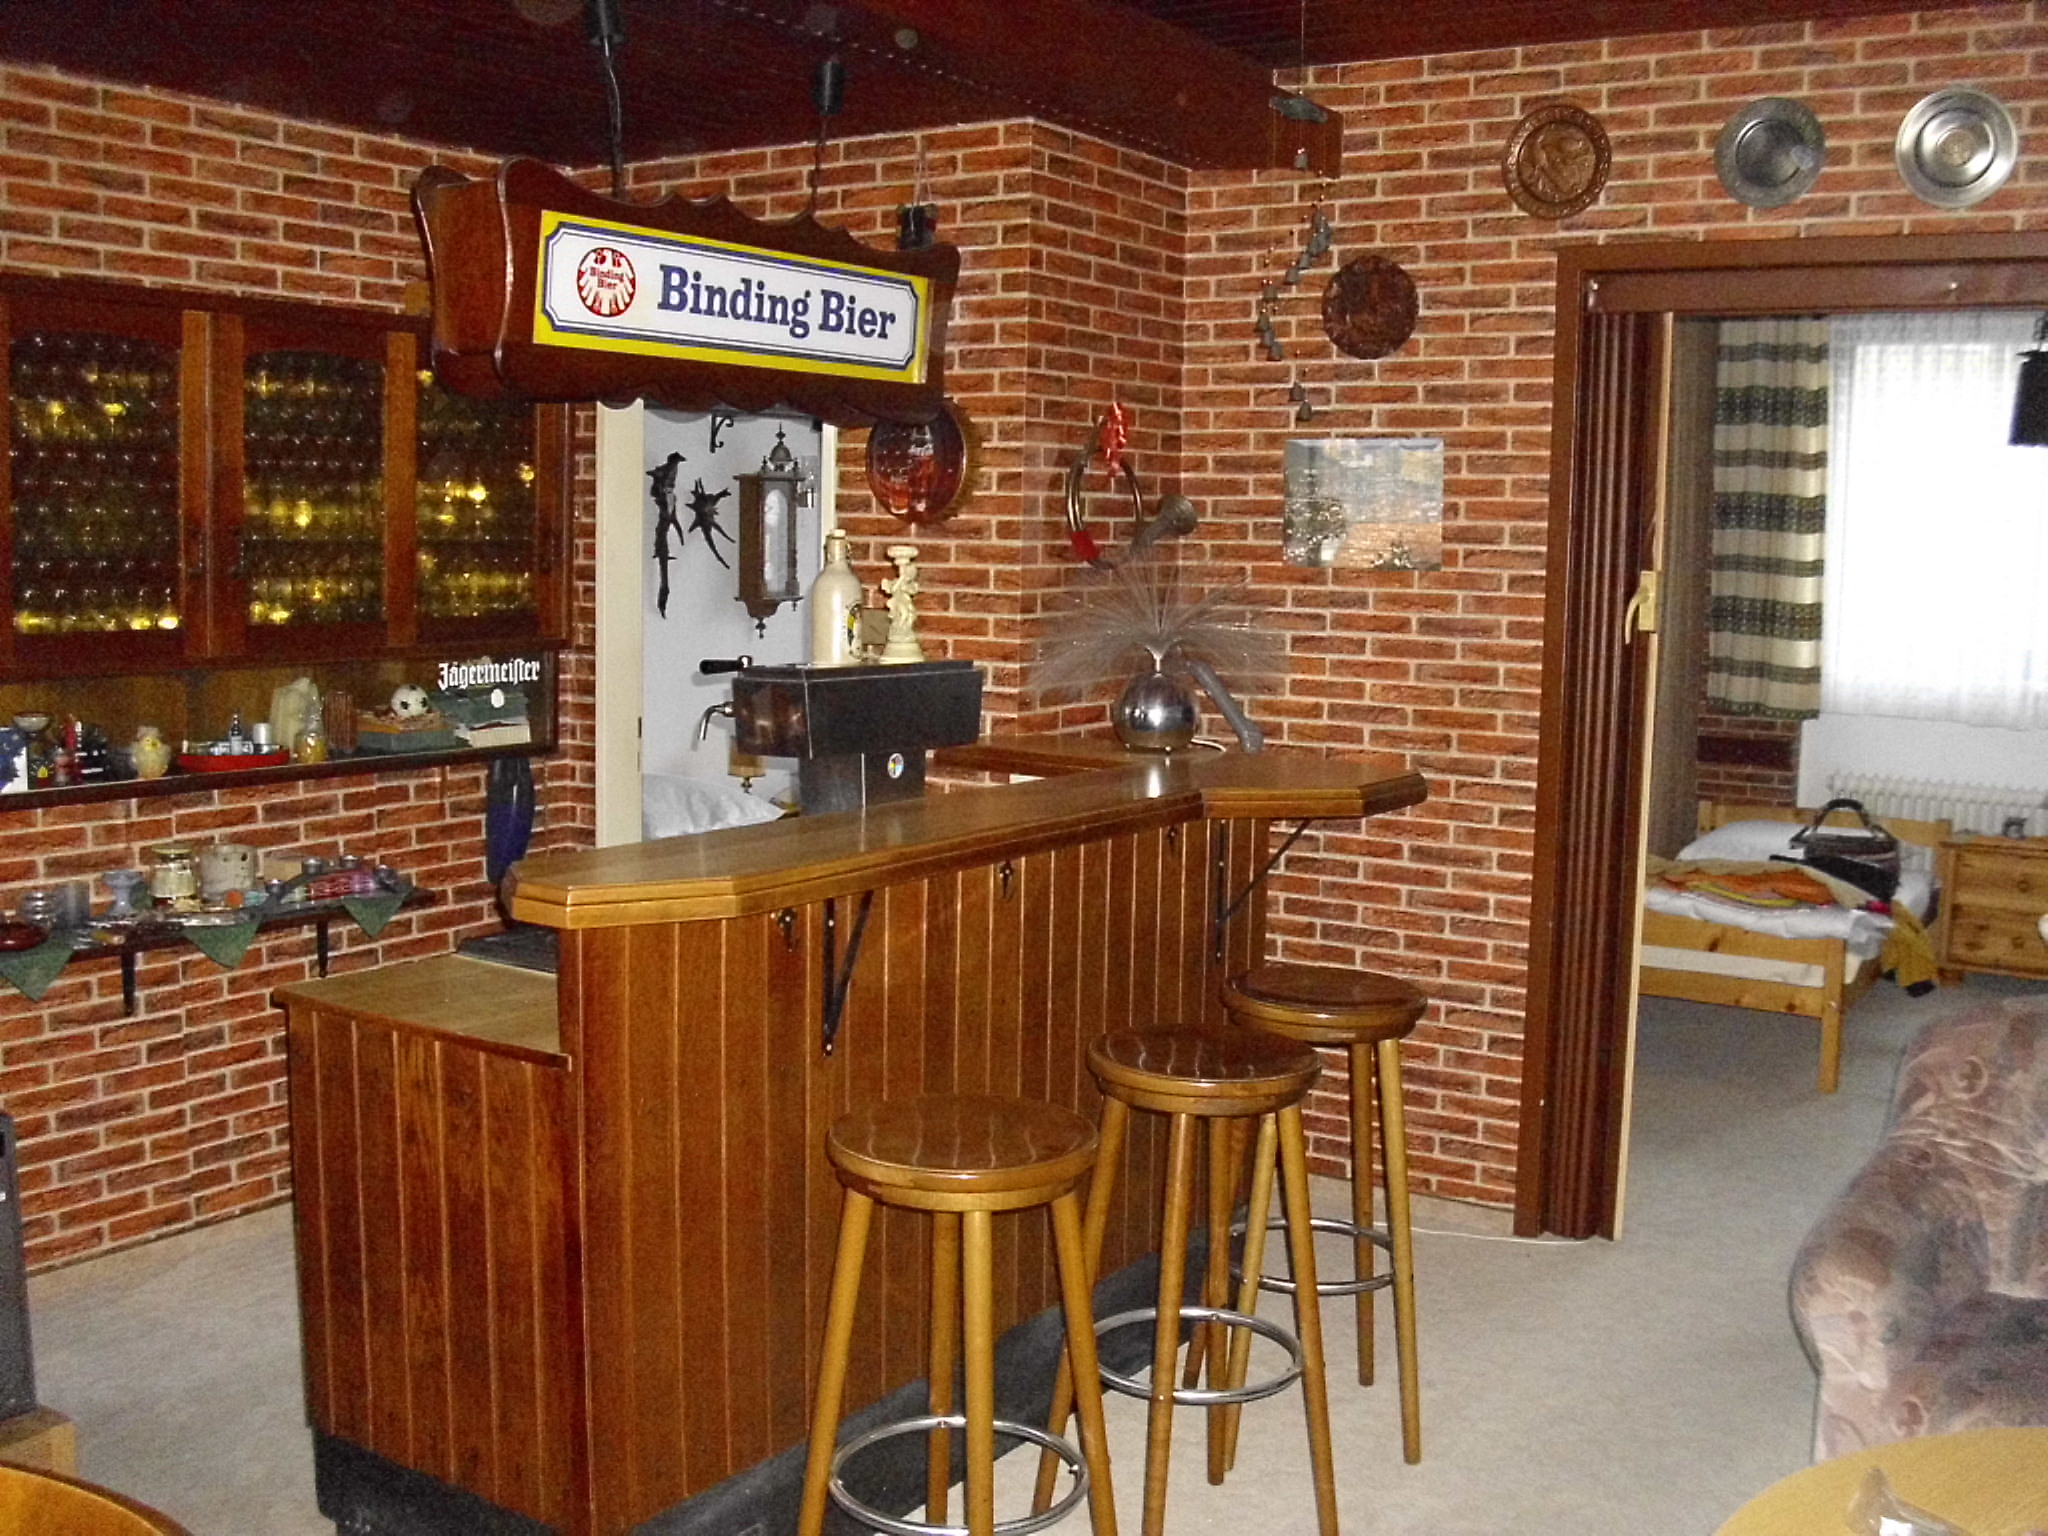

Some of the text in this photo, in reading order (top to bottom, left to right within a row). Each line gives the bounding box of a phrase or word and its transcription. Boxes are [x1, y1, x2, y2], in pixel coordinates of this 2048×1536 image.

[590, 266, 625, 282] Binding
[597, 278, 617, 290] Bier
[657, 264, 896, 340] Binding Bier
[438, 657, 540, 690] Jägermeister
